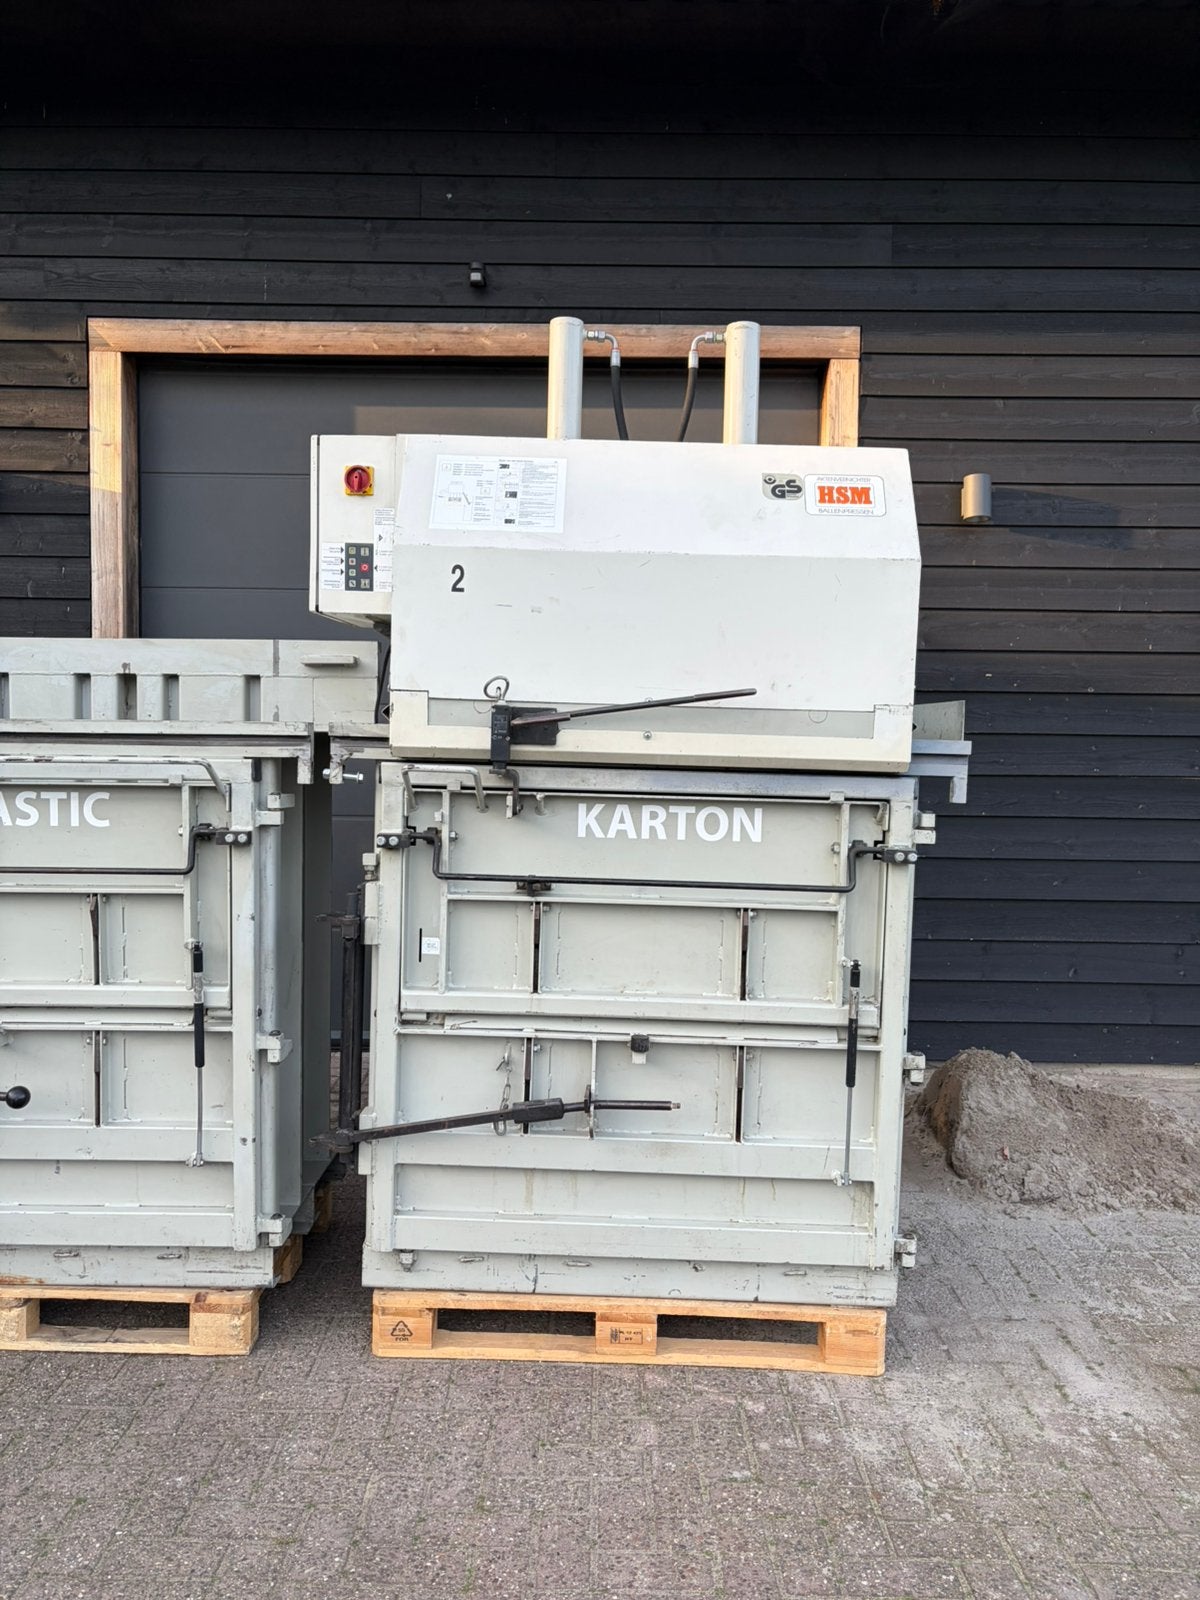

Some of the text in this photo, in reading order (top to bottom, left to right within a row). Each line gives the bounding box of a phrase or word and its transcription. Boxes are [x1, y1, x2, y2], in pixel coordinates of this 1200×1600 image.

[771, 479, 802, 498] GS
[817, 486, 872, 504] HSM
[451, 564, 465, 592] 2
[577, 803, 763, 842] KARTON
